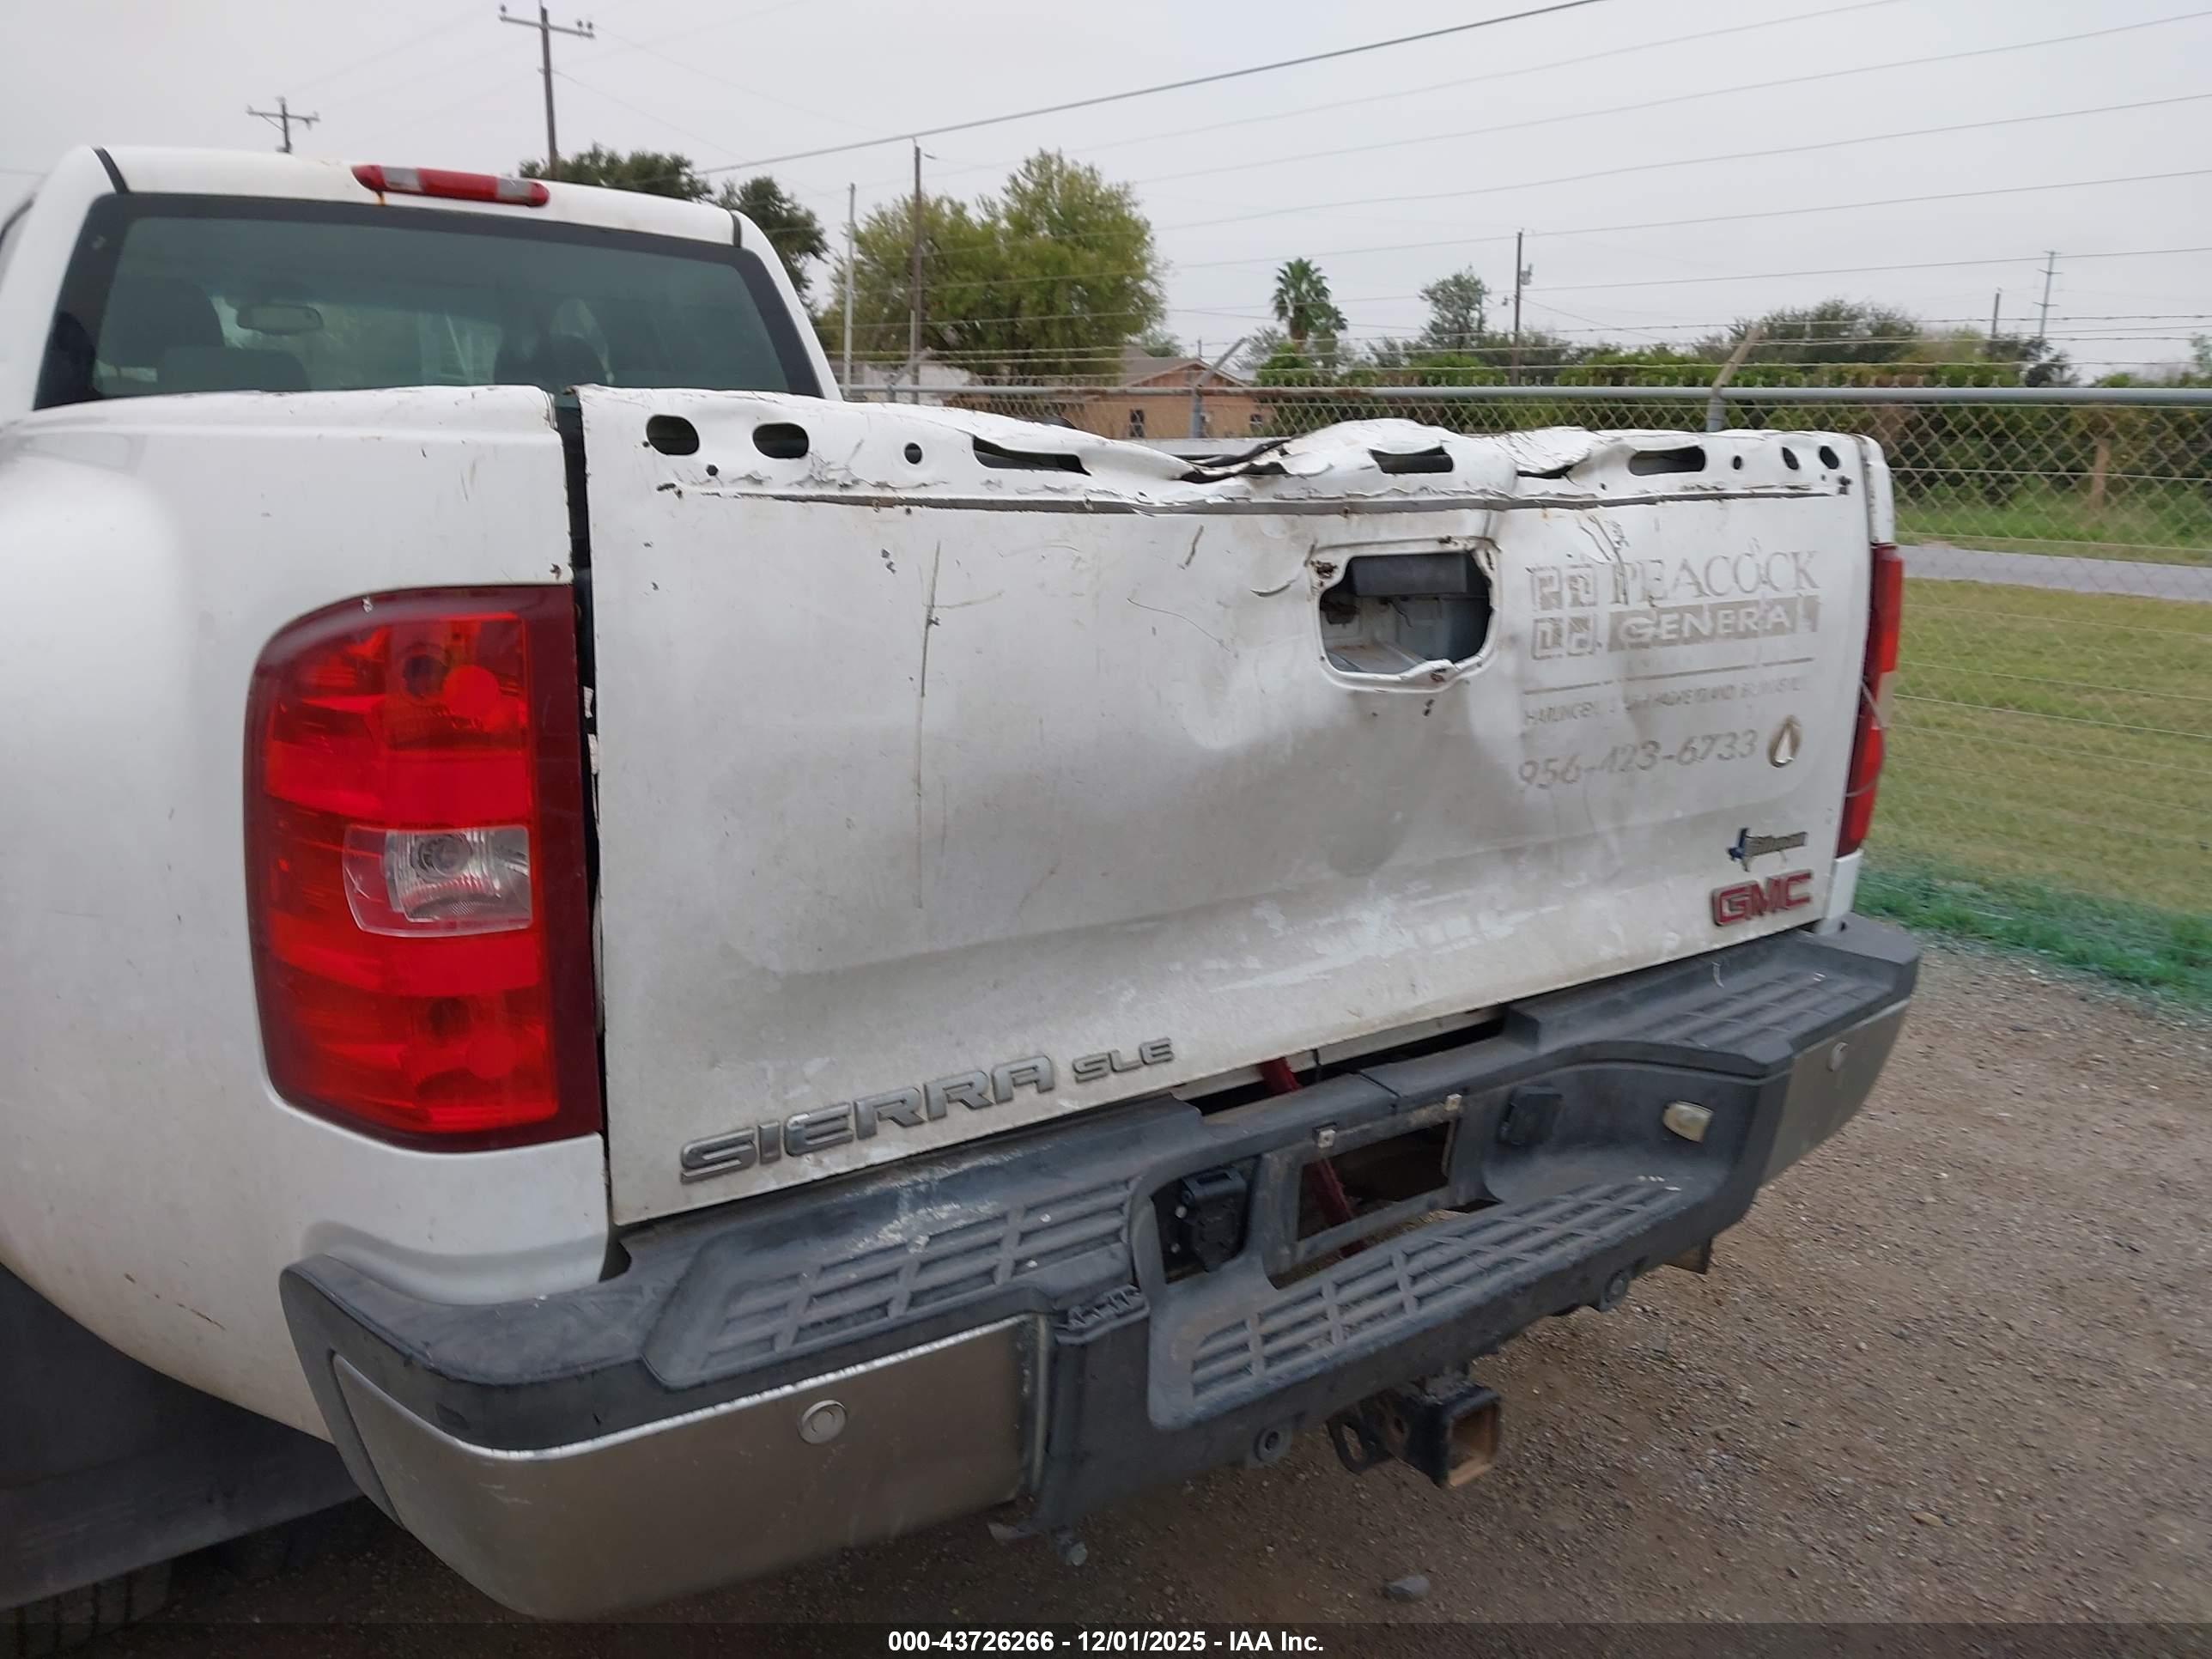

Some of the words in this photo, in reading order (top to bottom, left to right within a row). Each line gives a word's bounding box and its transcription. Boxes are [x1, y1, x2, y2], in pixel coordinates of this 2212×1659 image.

[1612, 550, 1820, 605] PEACOCK
[1710, 868, 1814, 927] GMC
[680, 1054, 1055, 1185] SIERRA
[1073, 1036, 1175, 1083] SLE
